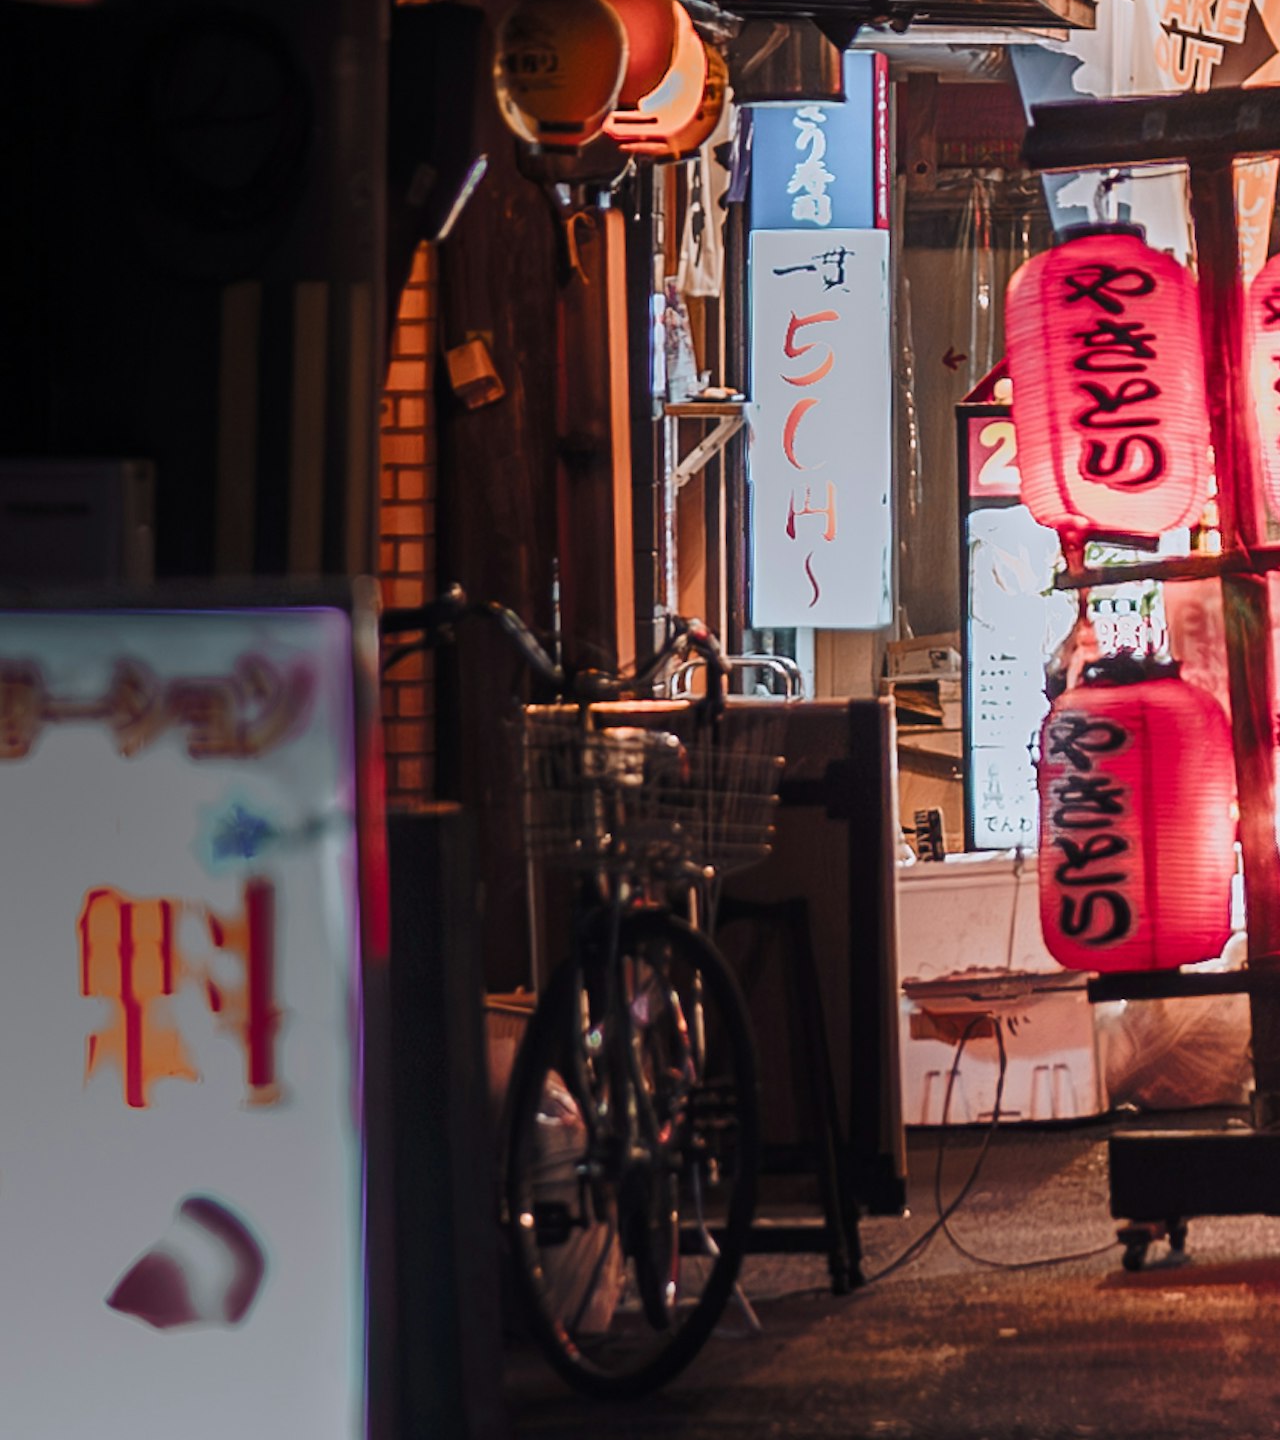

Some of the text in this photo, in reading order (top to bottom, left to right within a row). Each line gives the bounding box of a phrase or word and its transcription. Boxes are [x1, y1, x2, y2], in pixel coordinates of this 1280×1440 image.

[1064, 263, 1165, 487] やきとり
[1047, 714, 1134, 948] やきとり
